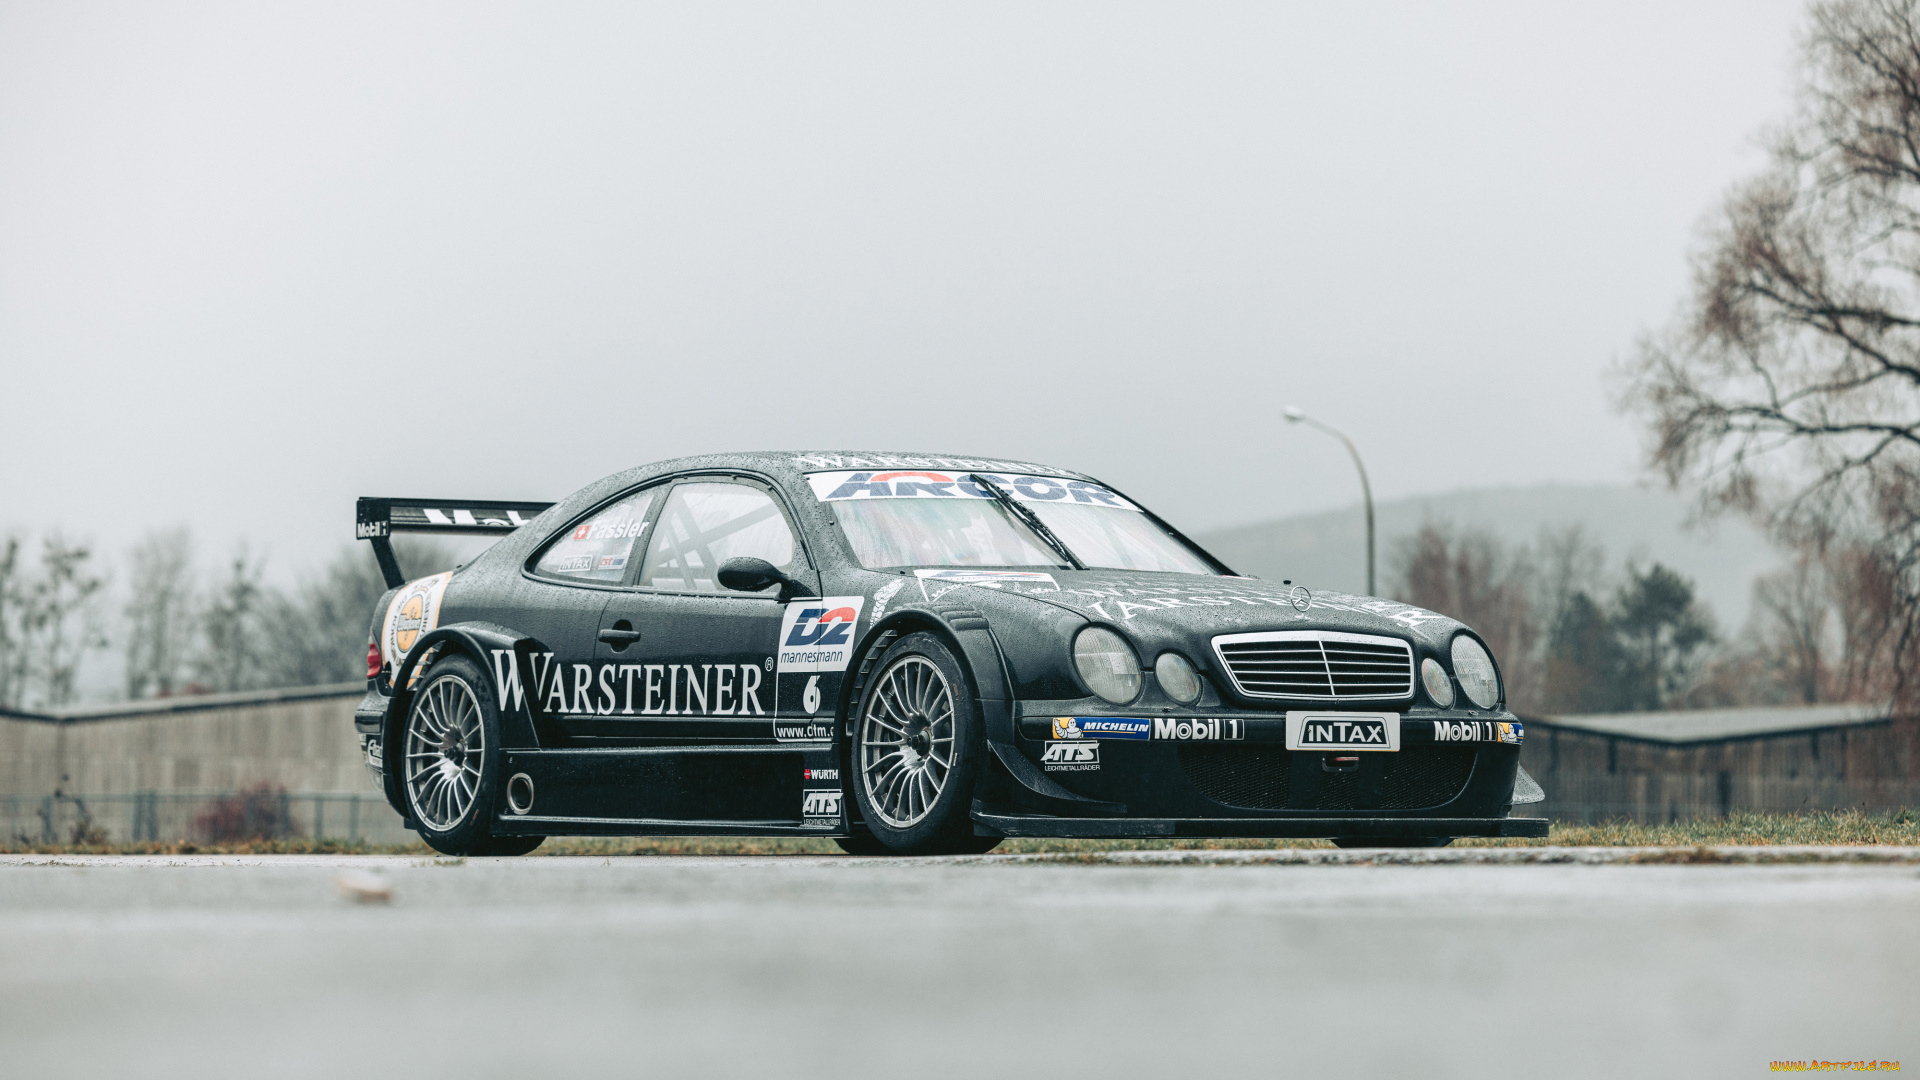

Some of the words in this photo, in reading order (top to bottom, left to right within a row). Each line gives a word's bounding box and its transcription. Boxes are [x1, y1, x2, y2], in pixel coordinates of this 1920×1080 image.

[826, 471, 1124, 506] ARCOR
[357, 521, 380, 538] Mobil
[585, 518, 650, 540] Fässler
[785, 607, 856, 646] D2
[780, 649, 843, 664] mannesmann
[803, 675, 821, 714] 6
[1083, 721, 1150, 732] MICHELIN
[1154, 718, 1220, 740] Mobil
[1229, 719, 1238, 739] 1
[1434, 721, 1481, 742] Mobil
[1040, 742, 1100, 761] ATS
[811, 769, 839, 780] WÜRTH
[803, 792, 844, 814] ATS
